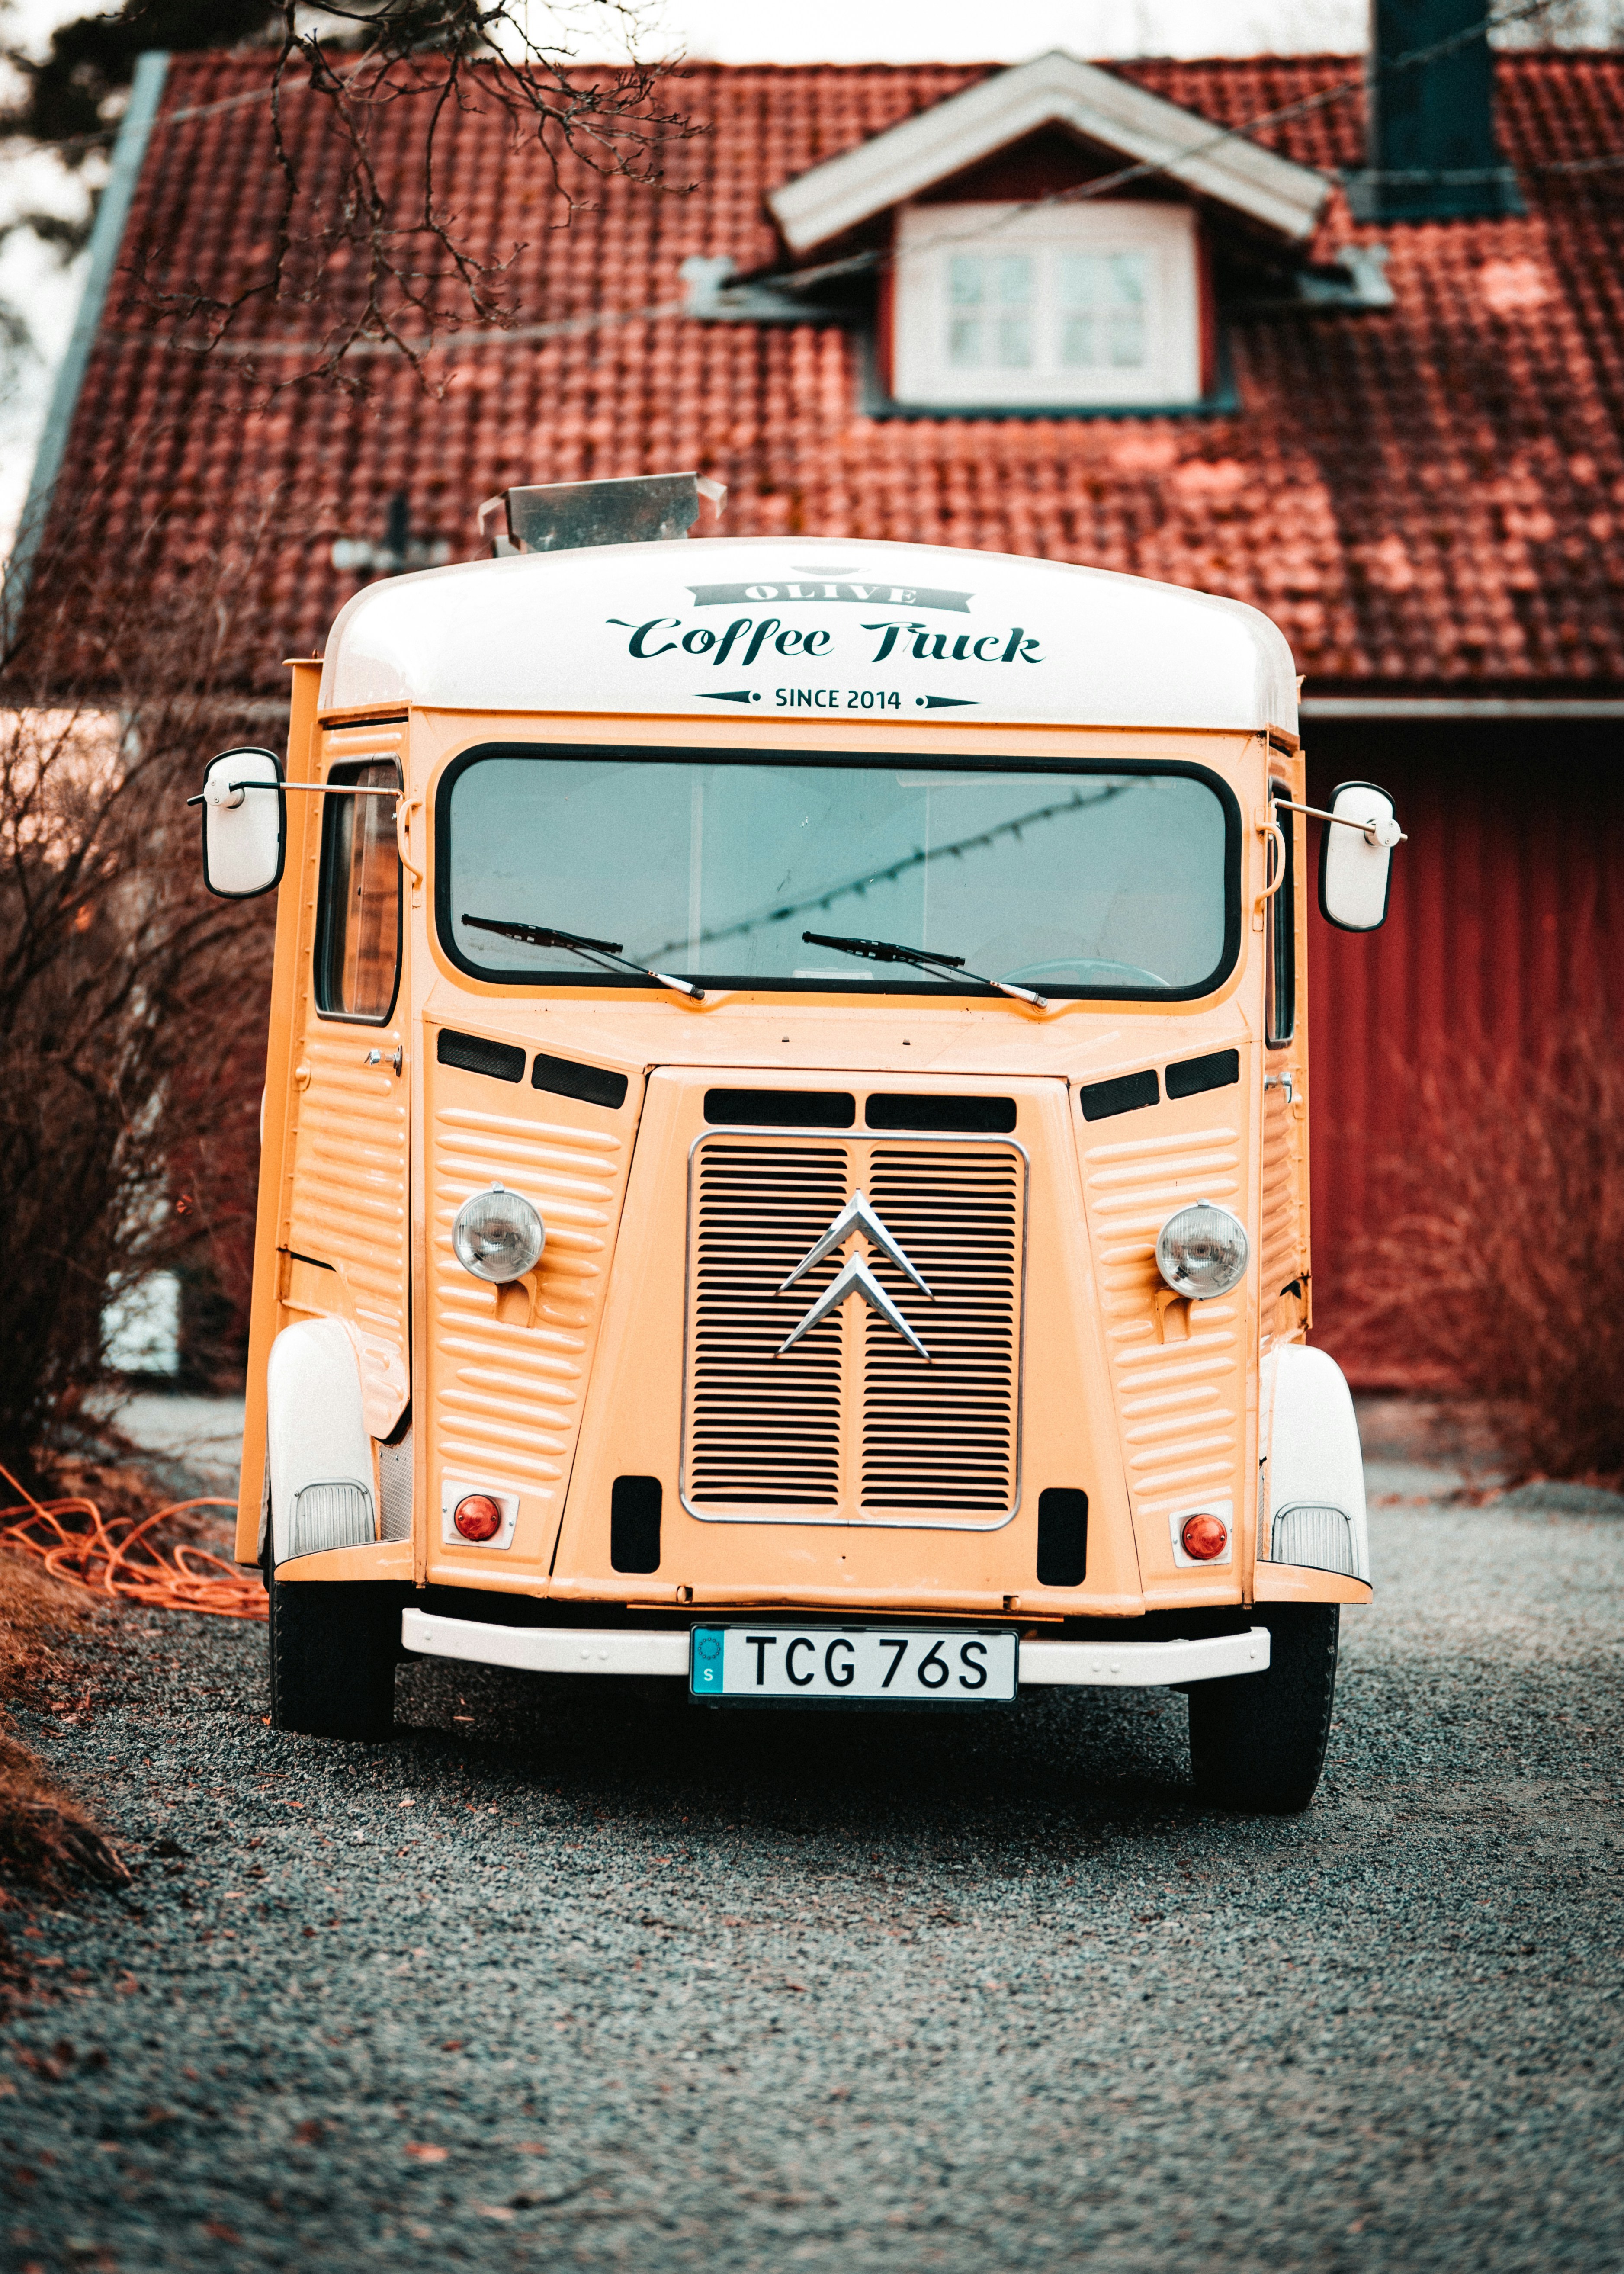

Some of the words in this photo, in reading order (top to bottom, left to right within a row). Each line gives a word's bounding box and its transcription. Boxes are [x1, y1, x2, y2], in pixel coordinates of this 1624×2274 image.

[745, 583, 918, 604] OLIVE
[606, 618, 834, 666] Coffee
[860, 622, 1046, 664] Truck
[775, 688, 839, 708] SINCE
[847, 690, 902, 710] 2014
[746, 1636, 855, 1687] TCG
[879, 1639, 988, 1689] 76S
[703, 1668, 713, 1682] S
